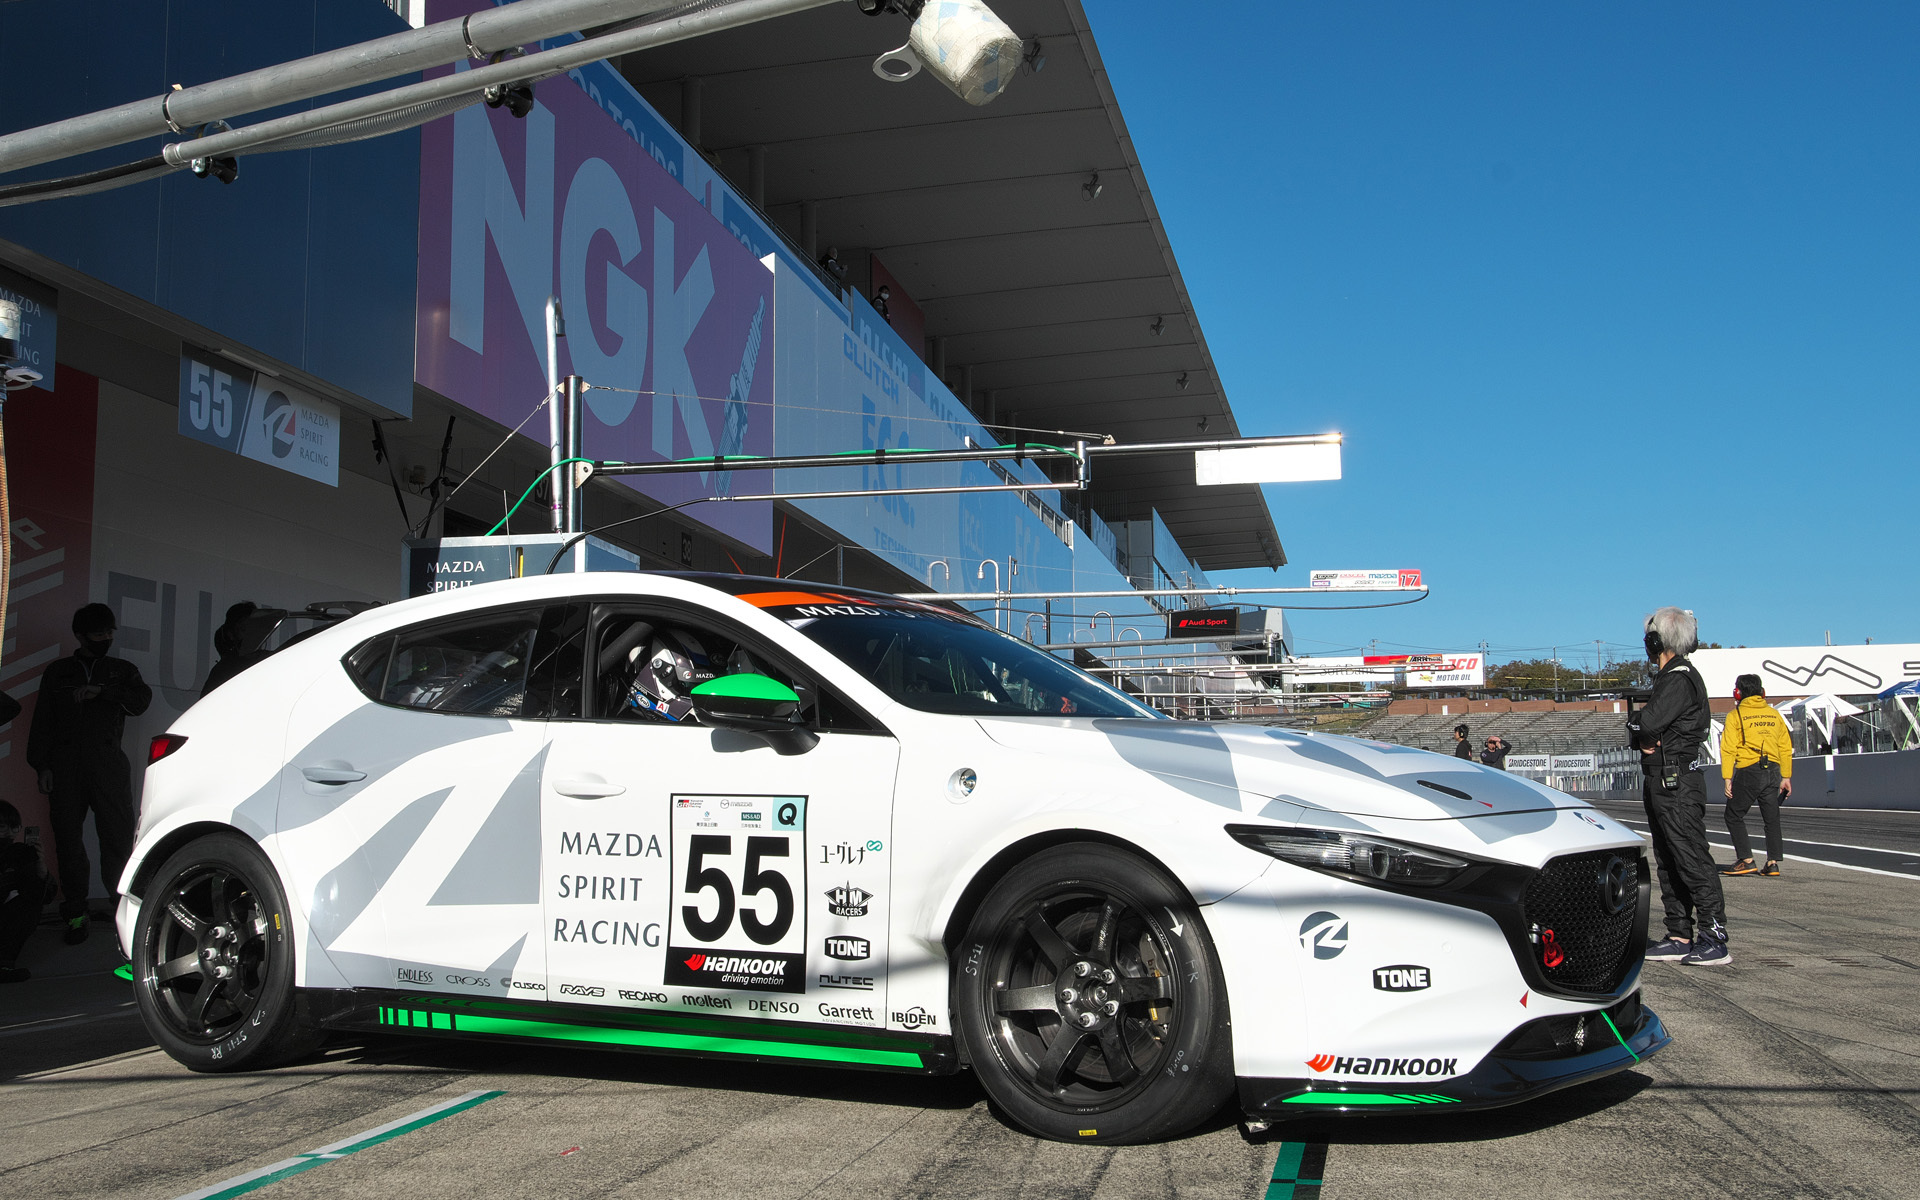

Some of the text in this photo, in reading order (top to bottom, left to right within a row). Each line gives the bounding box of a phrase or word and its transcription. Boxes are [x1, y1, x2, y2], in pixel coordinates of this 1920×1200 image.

[449, 58, 714, 489] NGK
[844, 333, 899, 405] CLUTCH
[190, 359, 233, 438] 55
[301, 408, 329, 429] MAZDA
[300, 428, 324, 445] SPIRIT
[299, 447, 329, 467] RACING
[682, 538, 692, 562] 38
[427, 561, 485, 574] MAZDA
[1400, 573, 1420, 587] 17
[795, 605, 894, 617] MAZDA
[1206, 618, 1228, 627] Sport
[1436, 674, 1460, 682] MOTOR
[1460, 673, 1471, 681] OIL
[1509, 758, 1547, 767] BRIDGESTONE
[1554, 758, 1591, 768] BRIDGESTONE
[777, 802, 797, 826] Q
[560, 831, 662, 858] MAZDA
[819, 841, 866, 865] ユーグレナ
[558, 874, 643, 902] SPIRIT
[682, 834, 794, 946] 55
[835, 906, 863, 917] RACERS
[553, 918, 661, 948] RACING
[828, 939, 868, 958] TONE
[398, 967, 433, 983] ENDLESS
[446, 974, 491, 988] CROSS
[722, 973, 784, 986] driving emotion
[1377, 968, 1428, 989] TONE
[560, 984, 605, 998] RAYS
[618, 989, 668, 1004] RECARO
[682, 995, 732, 1010] molten
[748, 999, 800, 1014] DENSO
[818, 1003, 874, 1021] Garrett
[891, 1011, 936, 1026] IBIDEN
